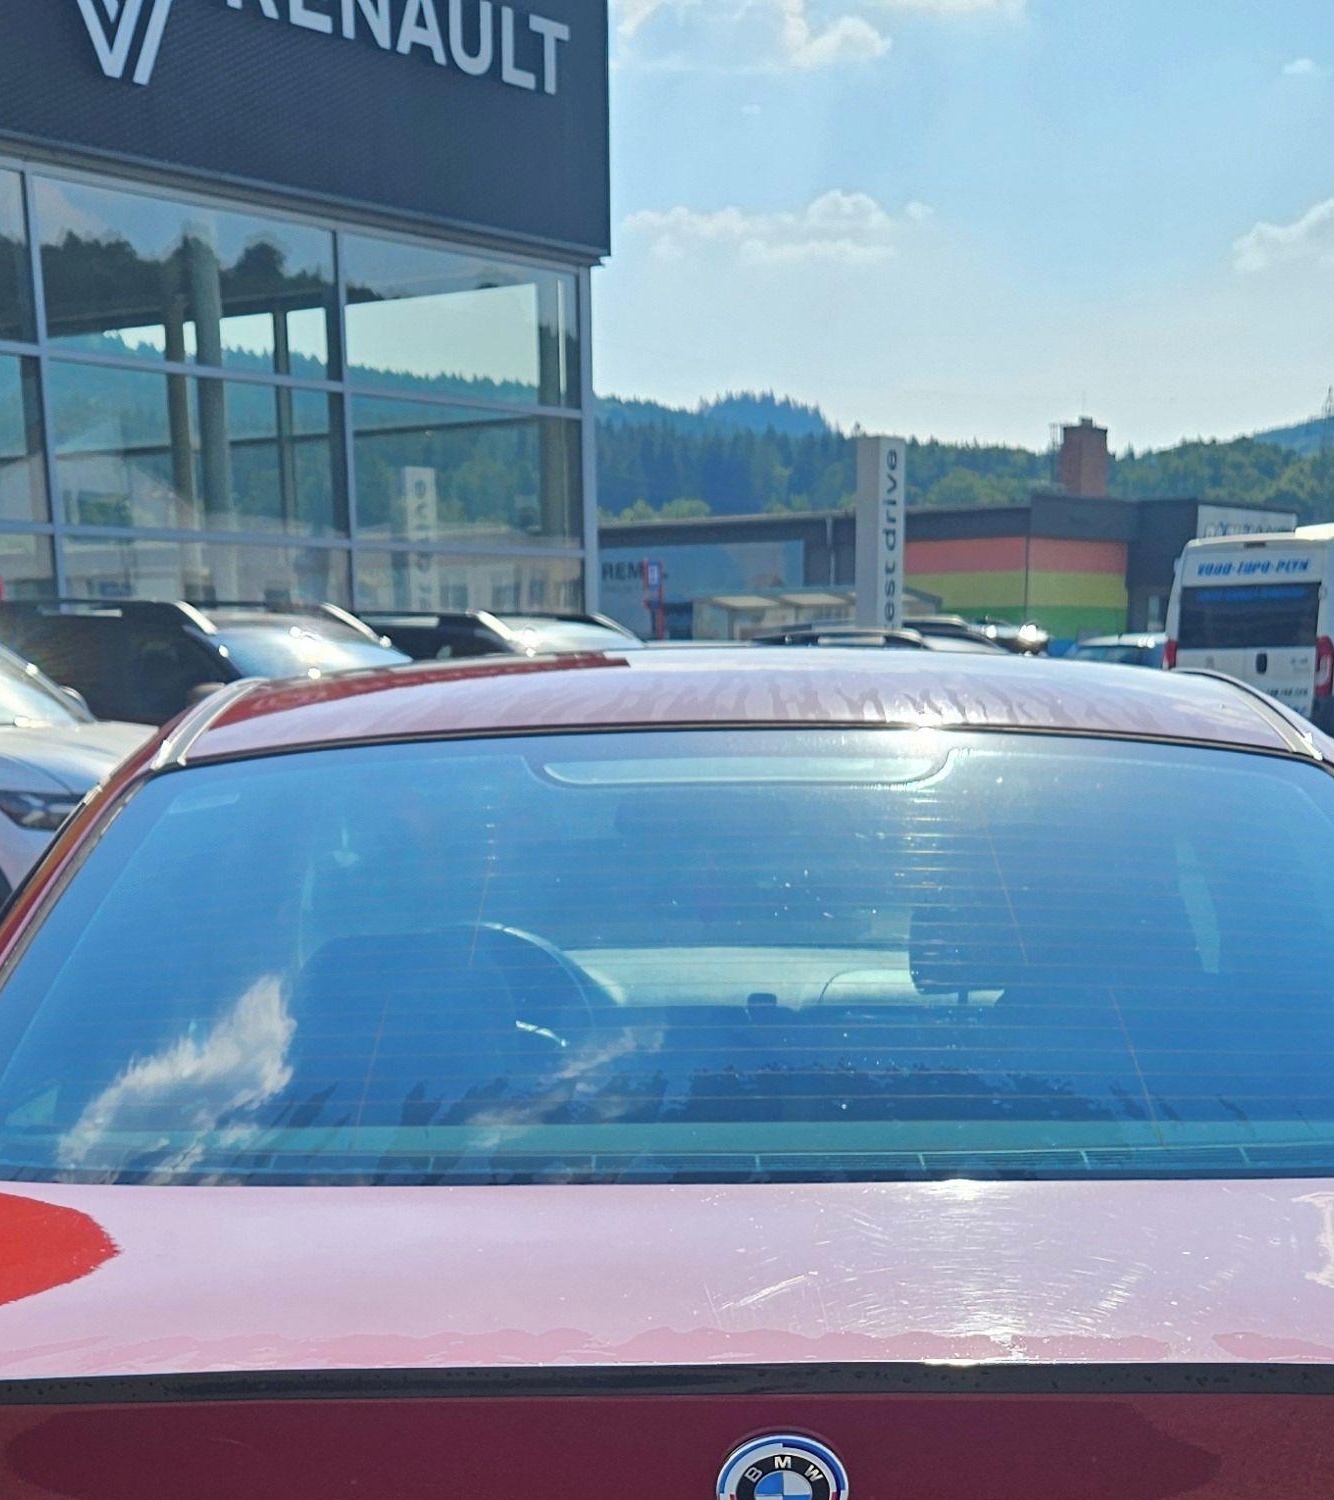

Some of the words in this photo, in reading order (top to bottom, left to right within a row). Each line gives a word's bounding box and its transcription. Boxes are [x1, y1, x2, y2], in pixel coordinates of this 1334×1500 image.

[227, 0, 571, 96] NAULT
[883, 449, 898, 551] drive
[744, 1456, 824, 1483] BMW
